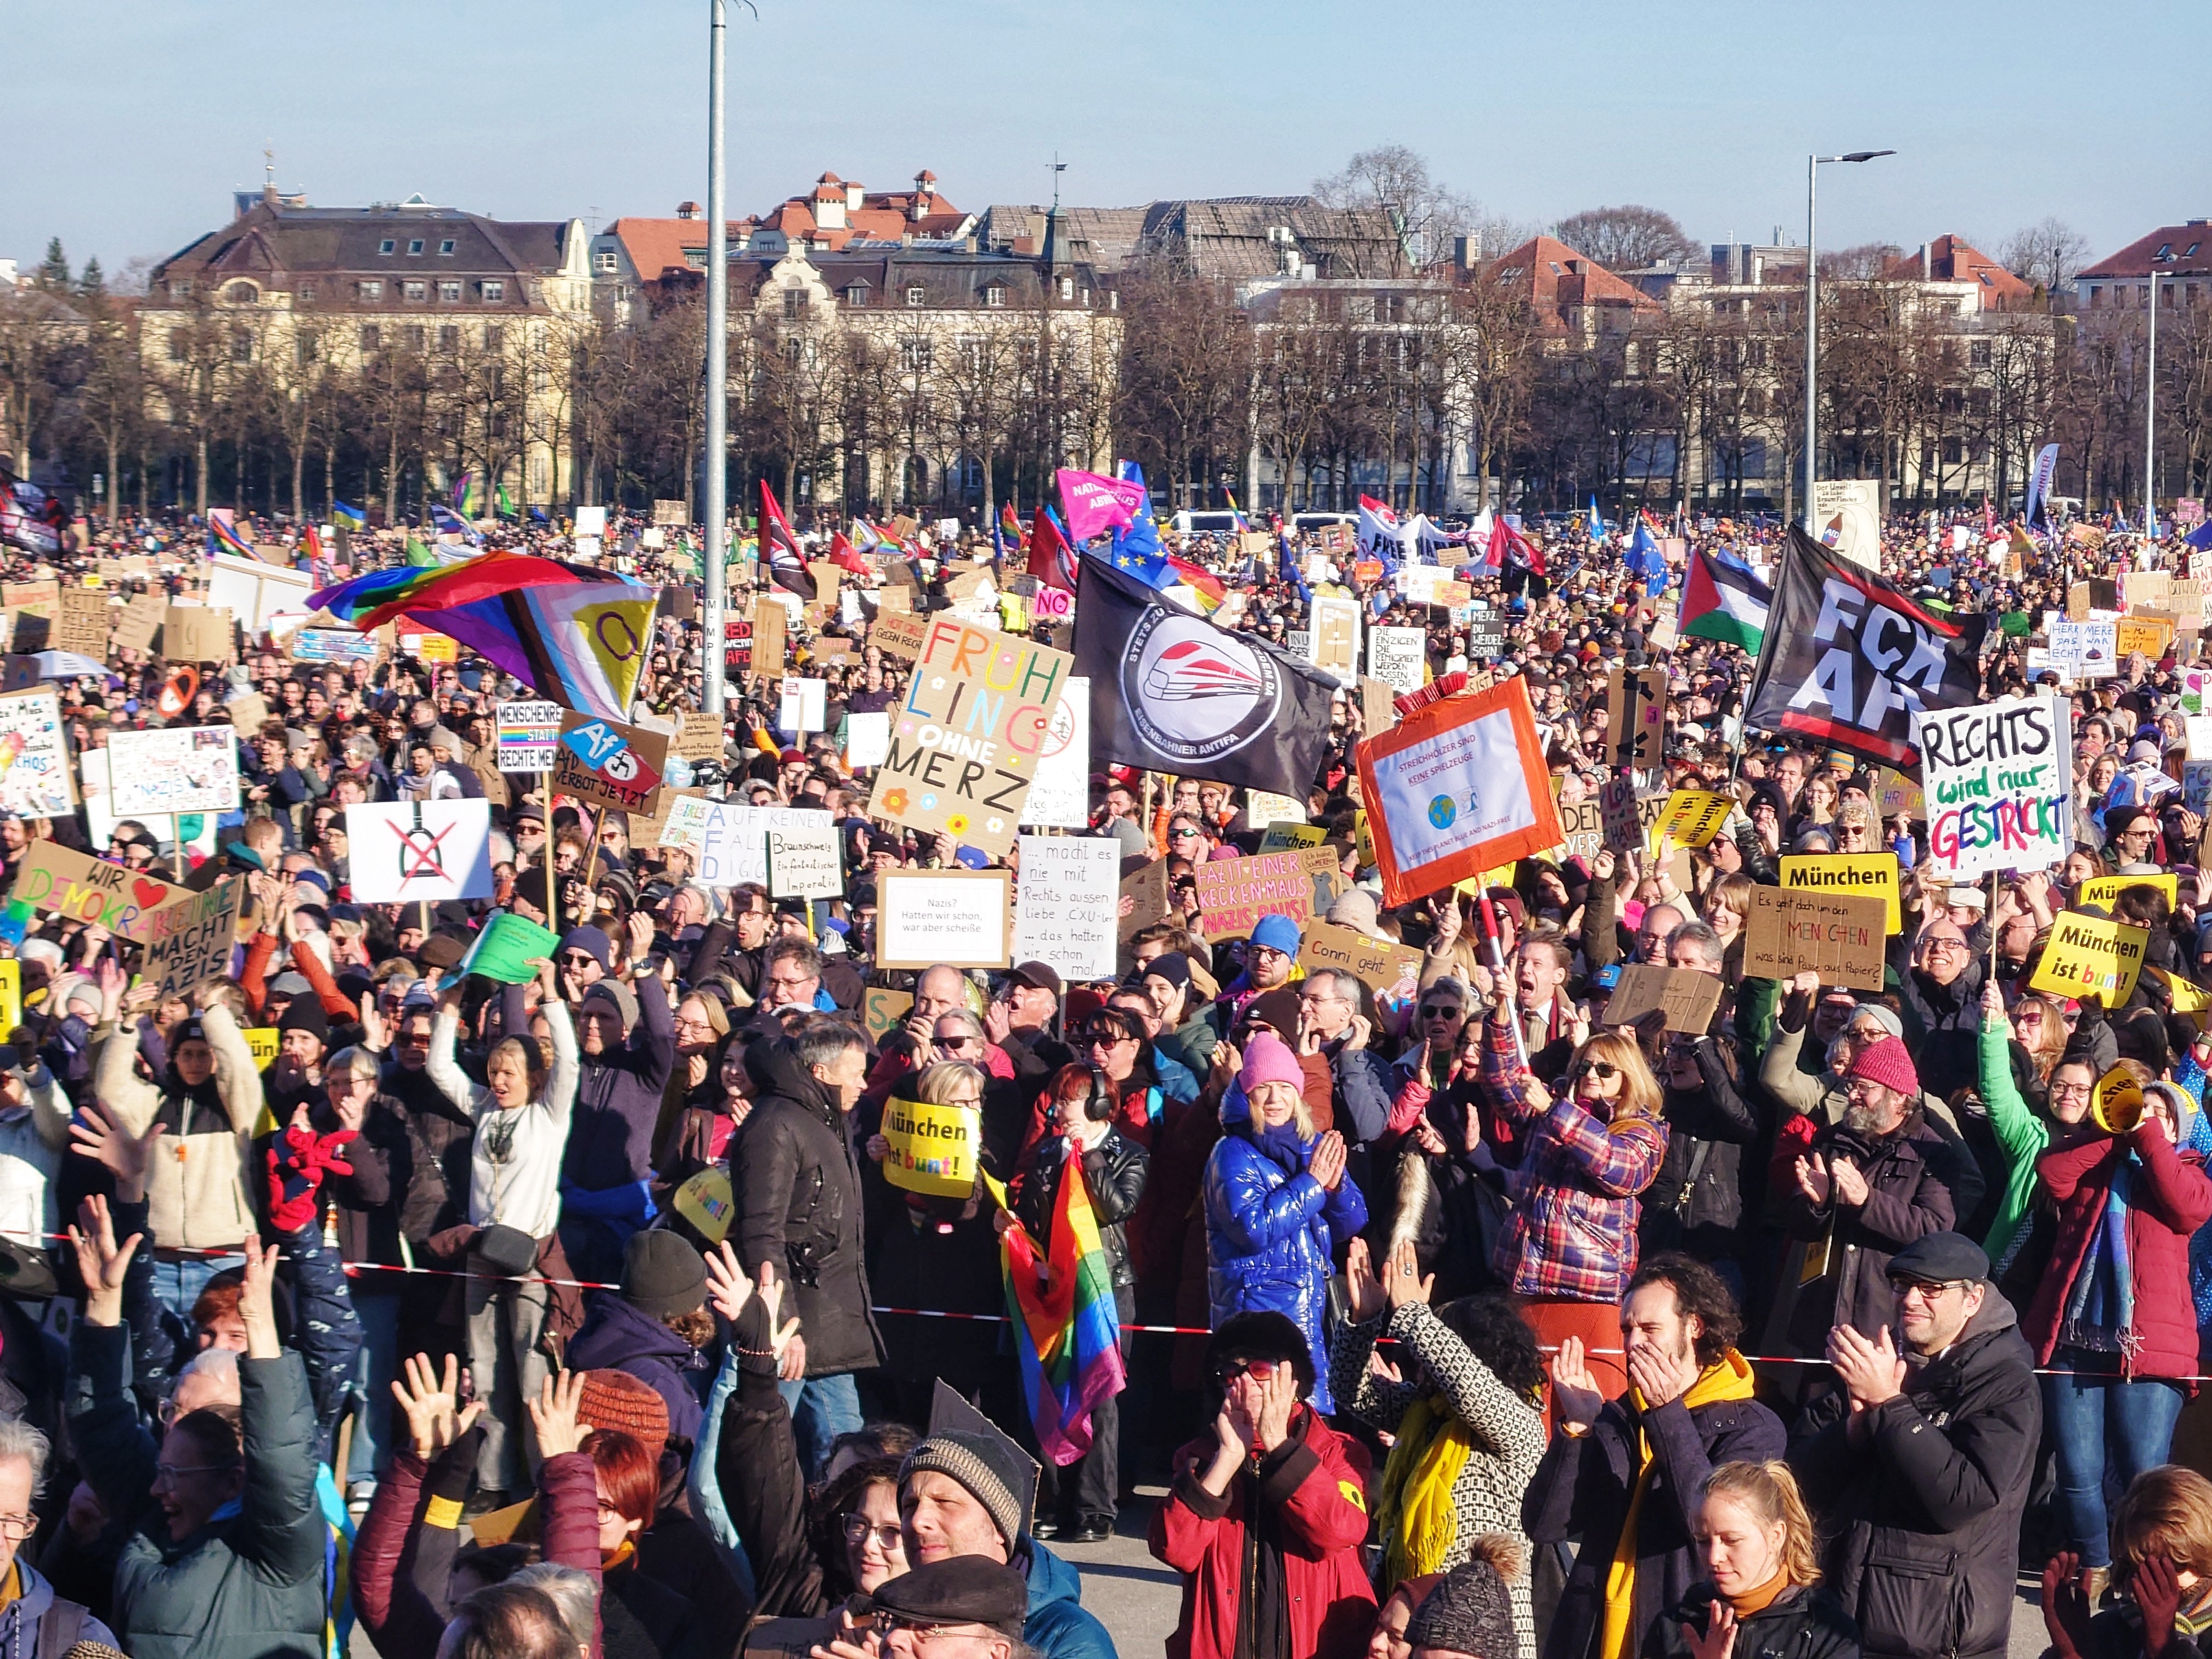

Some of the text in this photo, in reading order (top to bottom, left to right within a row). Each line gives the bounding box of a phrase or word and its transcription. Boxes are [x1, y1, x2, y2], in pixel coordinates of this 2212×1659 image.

[2191, 555, 2203, 568] ES
[1037, 592, 1068, 613] NO
[877, 628, 899, 642] GEGEN
[1130, 608, 1165, 662] STETS ZU
[1291, 634, 1301, 645] IN
[1376, 628, 1390, 636] DIE
[1473, 624, 1485, 634] DU
[1813, 577, 1950, 694] FCK
[2053, 625, 2113, 635] HERR MERZ
[723, 638, 753, 647] wenn
[1376, 637, 1417, 646] EINZIGEN
[1376, 645, 1391, 653] DIE
[726, 651, 751, 664] AFD
[923, 622, 1060, 704] FRÜH
[2052, 648, 2081, 658] ECHT
[1264, 683, 1274, 696] DA
[498, 705, 562, 723] MENSCHENRE
[907, 670, 1043, 754] LING
[528, 728, 555, 742] STATT
[1135, 708, 1239, 754] EISENBAHNER ANTIFA
[1922, 707, 2051, 773] RECHTS
[918, 724, 997, 766] OHNE
[1400, 735, 1476, 772] STREICHHÖLZER SIND
[500, 749, 534, 767] RECHTE
[1408, 752, 1474, 785] KEINE SPIELZEUGE
[884, 737, 1029, 813] MERZ
[1937, 764, 2049, 804] wird nur
[140, 778, 184, 795] NAZIS
[554, 770, 650, 811] VERBOT JETZT
[1679, 797, 1700, 809] ist
[770, 811, 828, 827] KEINEN
[1685, 797, 1725, 843] München
[1265, 832, 1316, 849] München
[1434, 839, 1454, 850] PLANET
[1455, 832, 1468, 842] BLUE
[1470, 827, 1481, 836] AND
[1482, 816, 1511, 831] NAZI-FREE
[1611, 820, 1641, 845] HATE
[773, 833, 831, 854] Braunschweig
[1047, 842, 1111, 860] macht es
[778, 859, 837, 874] Ein fantastischer
[1030, 864, 1087, 882] nie mit
[1197, 853, 1299, 886] FAZIT EINER
[1789, 866, 1887, 887] München
[86, 862, 126, 893] WIR
[787, 876, 836, 893] Imperativ
[22, 868, 148, 936] DEMOKRA
[928, 899, 957, 907] Nazis?
[1023, 886, 1061, 901] Rechts
[1199, 881, 1261, 909] KECKEN
[1758, 892, 1770, 906] Es
[1776, 896, 1793, 912] geht
[1796, 900, 1814, 910] doch
[1832, 904, 1848, 915] den
[154, 879, 235, 939] KEINE
[902, 911, 933, 919] Hatten
[953, 912, 982, 921] schon,
[1026, 908, 1054, 919] liebe
[923, 924, 943, 932] aber
[946, 924, 981, 932] scheiße
[1203, 909, 1253, 933] NAZIS
[148, 910, 232, 965] MACHT
[1040, 928, 1103, 941] das hatten
[1788, 922, 1868, 946] MENSCHEN
[2059, 926, 2138, 958] München
[168, 943, 210, 970] DEN
[1024, 944, 1082, 960] wir schon
[1312, 941, 1385, 974] Conni geht
[156, 949, 226, 1000] AZIS
[1756, 952, 1773, 962] was
[1778, 952, 1793, 964] sind
[1846, 961, 1881, 983] Papier?
[2051, 957, 2129, 990] ist bunt!
[904, 1155, 959, 1178] bunt!
